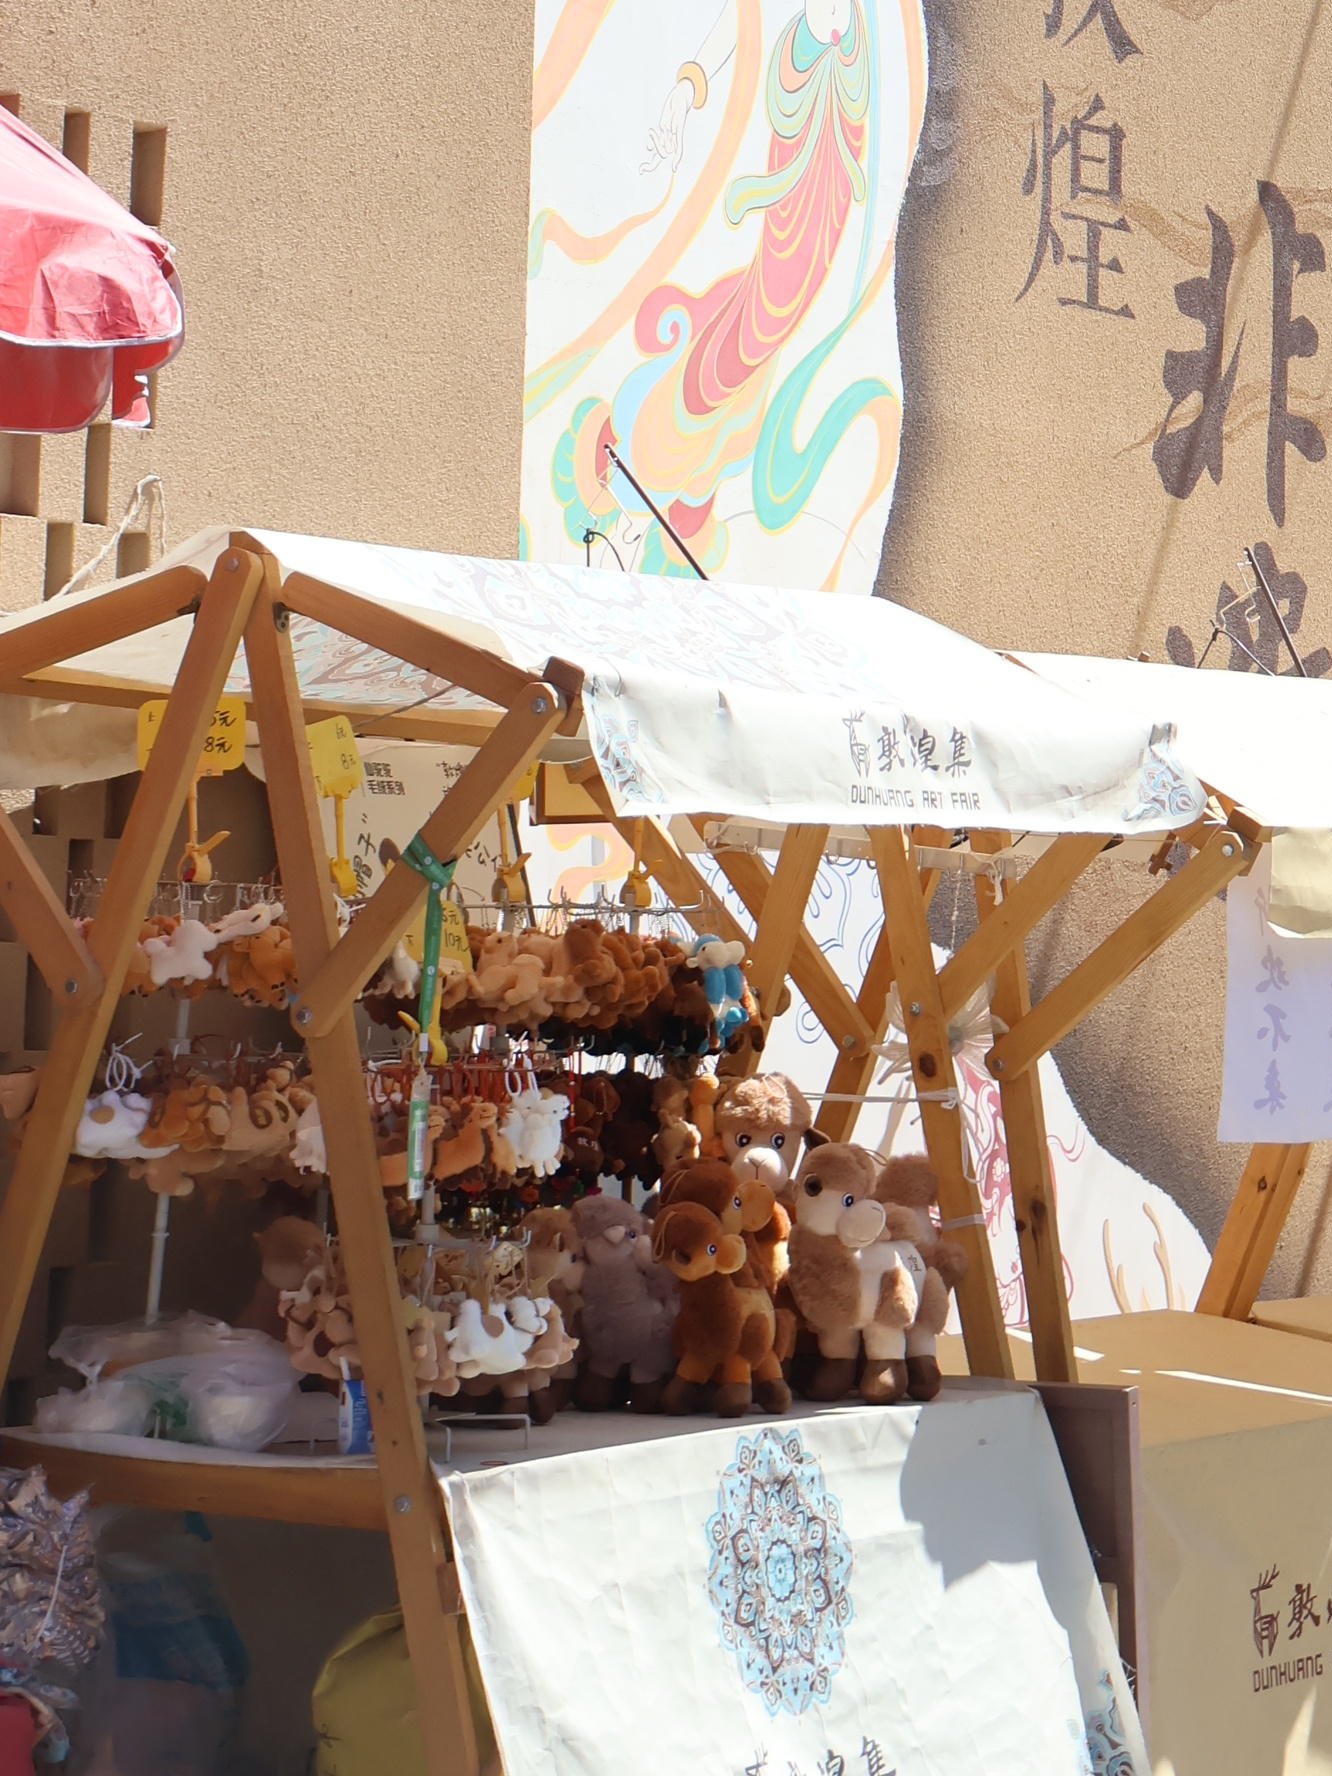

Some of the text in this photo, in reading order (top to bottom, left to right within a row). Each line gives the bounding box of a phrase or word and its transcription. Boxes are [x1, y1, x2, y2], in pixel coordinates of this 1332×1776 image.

[203, 736, 233, 754] 8元
[877, 725, 972, 778] 敦煌集
[851, 784, 981, 811] DUNHUANG ART FAIR
[1253, 1653, 1323, 1693] DUNHUANG
